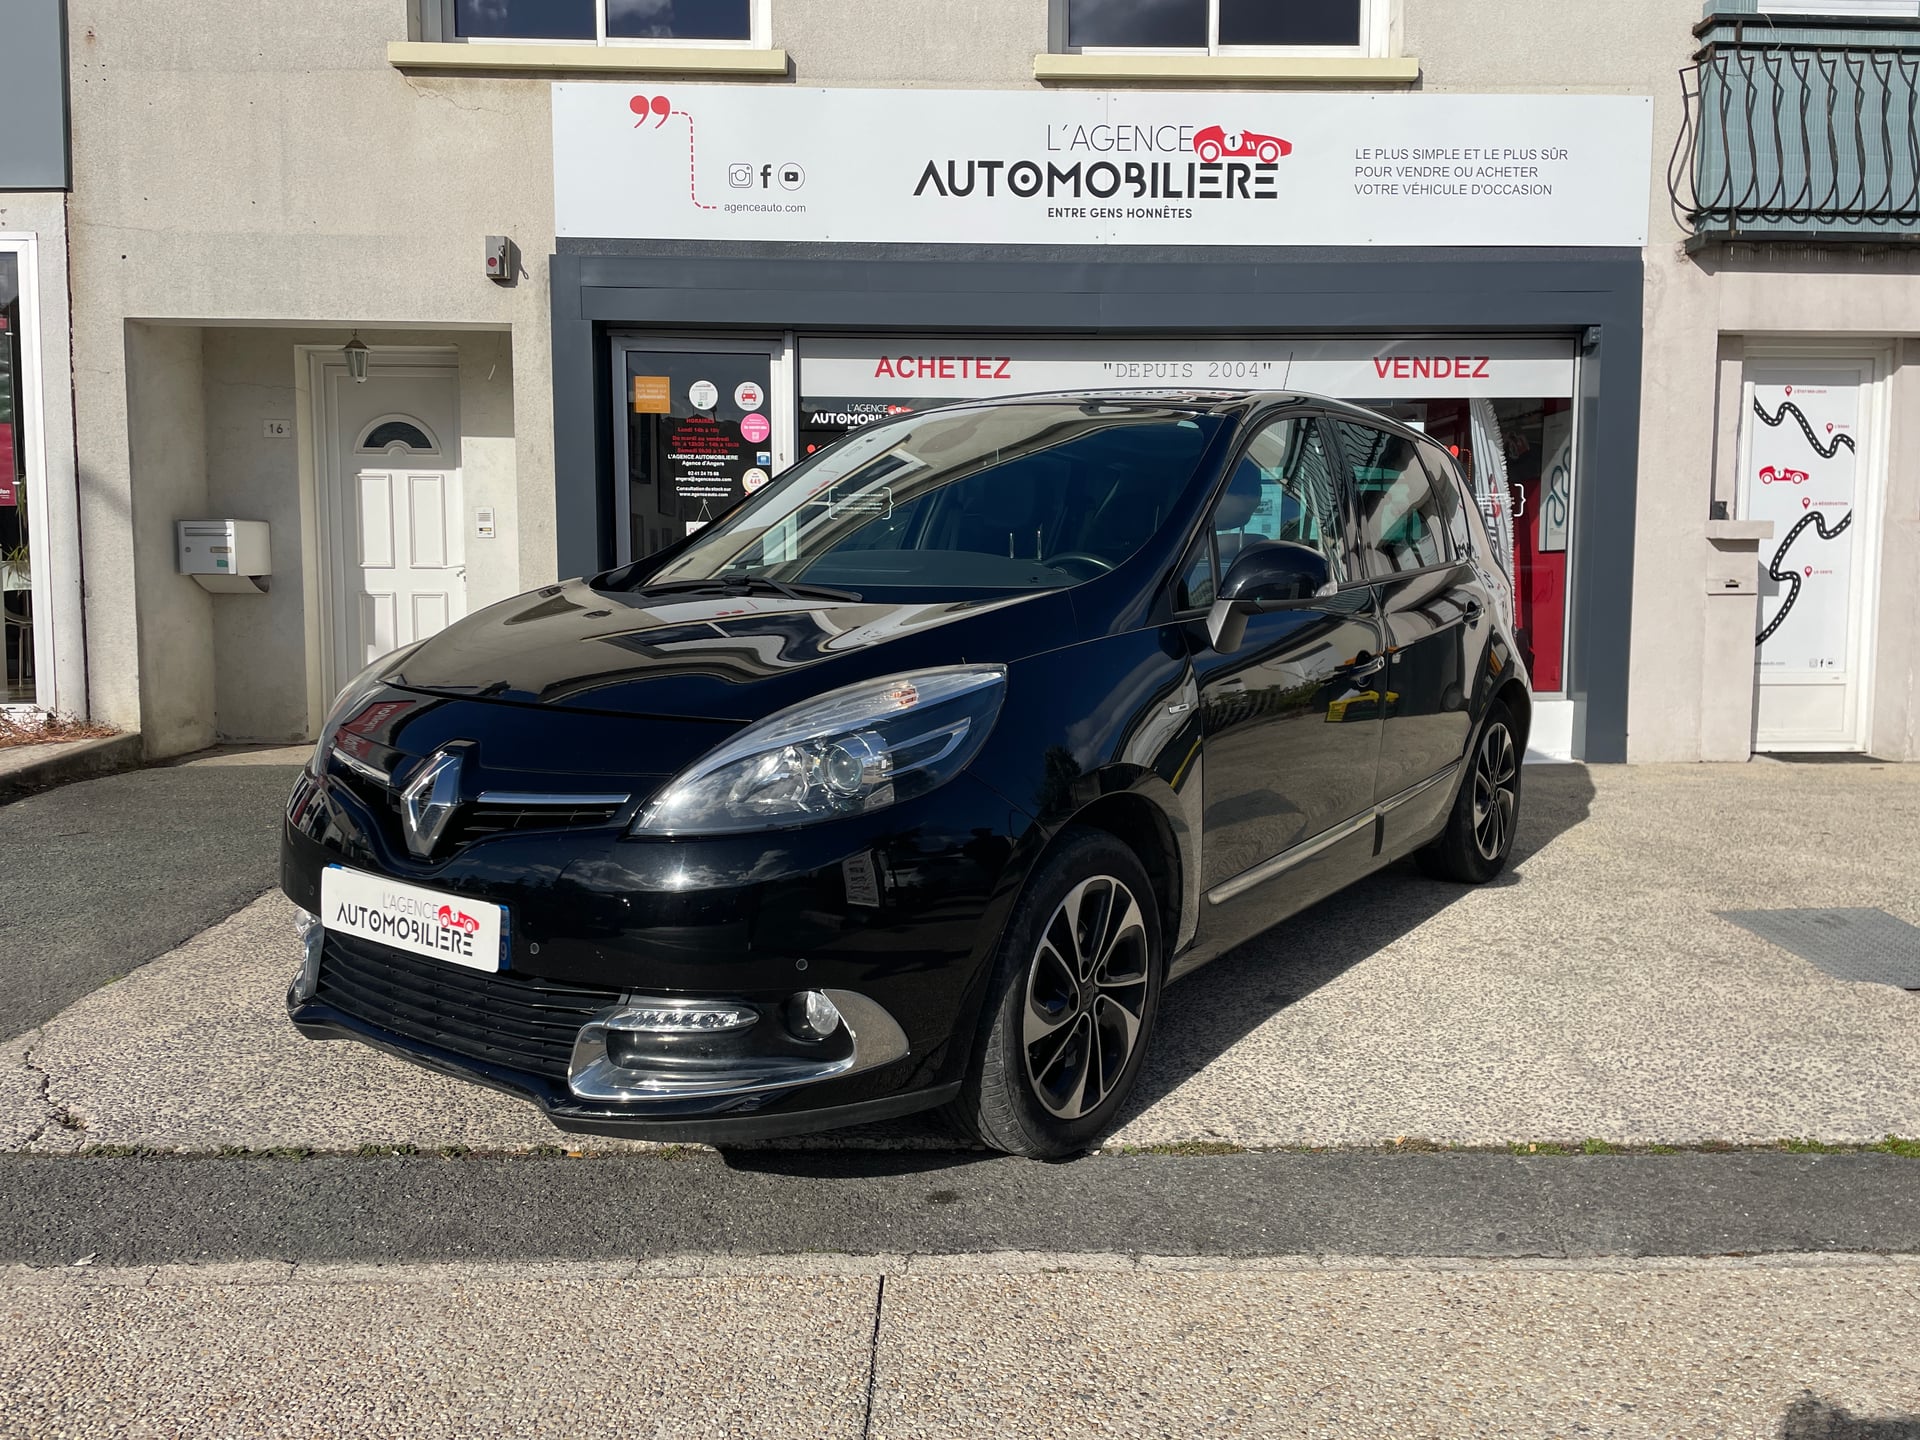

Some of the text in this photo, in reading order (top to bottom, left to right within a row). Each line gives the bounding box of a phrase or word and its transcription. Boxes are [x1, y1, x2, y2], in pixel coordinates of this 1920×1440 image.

[1047, 124, 1194, 152] L'AGENCE
[1355, 147, 1569, 160] LE PLUS SIMPLE ET LE PLUS SÛR
[1355, 166, 1539, 177] POUR VENDRE OU ACHETER
[912, 160, 1279, 202] AUTOMOBILIERE
[1354, 181, 1553, 195] VOTRE VÉHICULE D'OCCASION
[723, 203, 807, 214] agenceauto.com
[1047, 205, 1193, 219] ENTRE GENS HONNÊTES
[874, 355, 1011, 379] ACHETEZ
[1373, 356, 1490, 379] VENDEZ
[847, 404, 887, 412] L'AGENCE
[270, 423, 284, 434] 16
[382, 891, 439, 922] L'AGENCE
[336, 902, 474, 957] AUTOMOBILIERE
